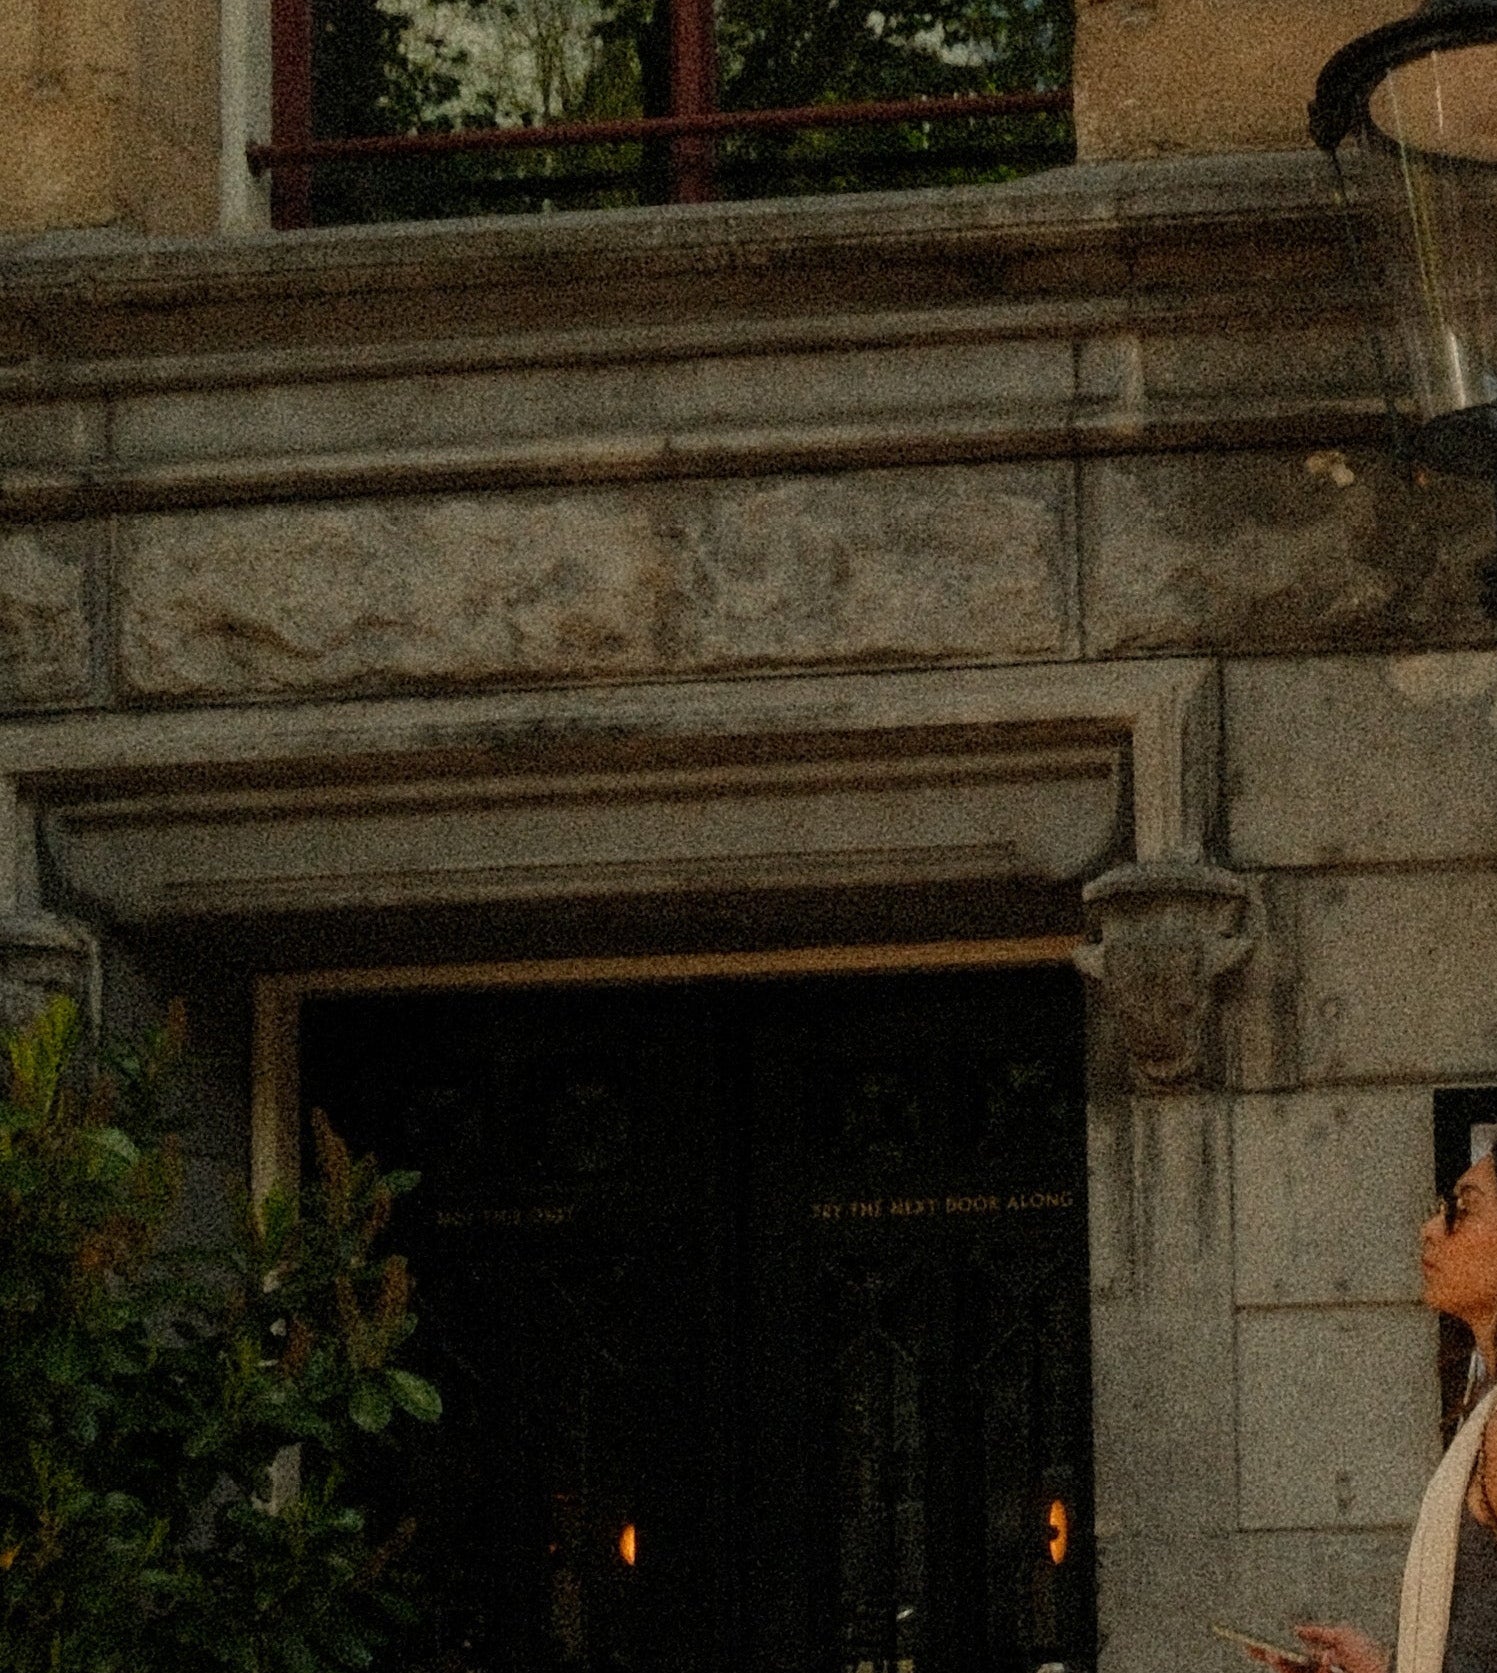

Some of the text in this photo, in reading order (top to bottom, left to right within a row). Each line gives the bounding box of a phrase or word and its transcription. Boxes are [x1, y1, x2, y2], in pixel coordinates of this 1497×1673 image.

[811, 1191, 1074, 1219] TRY THE NEXT DOOR ALONG
